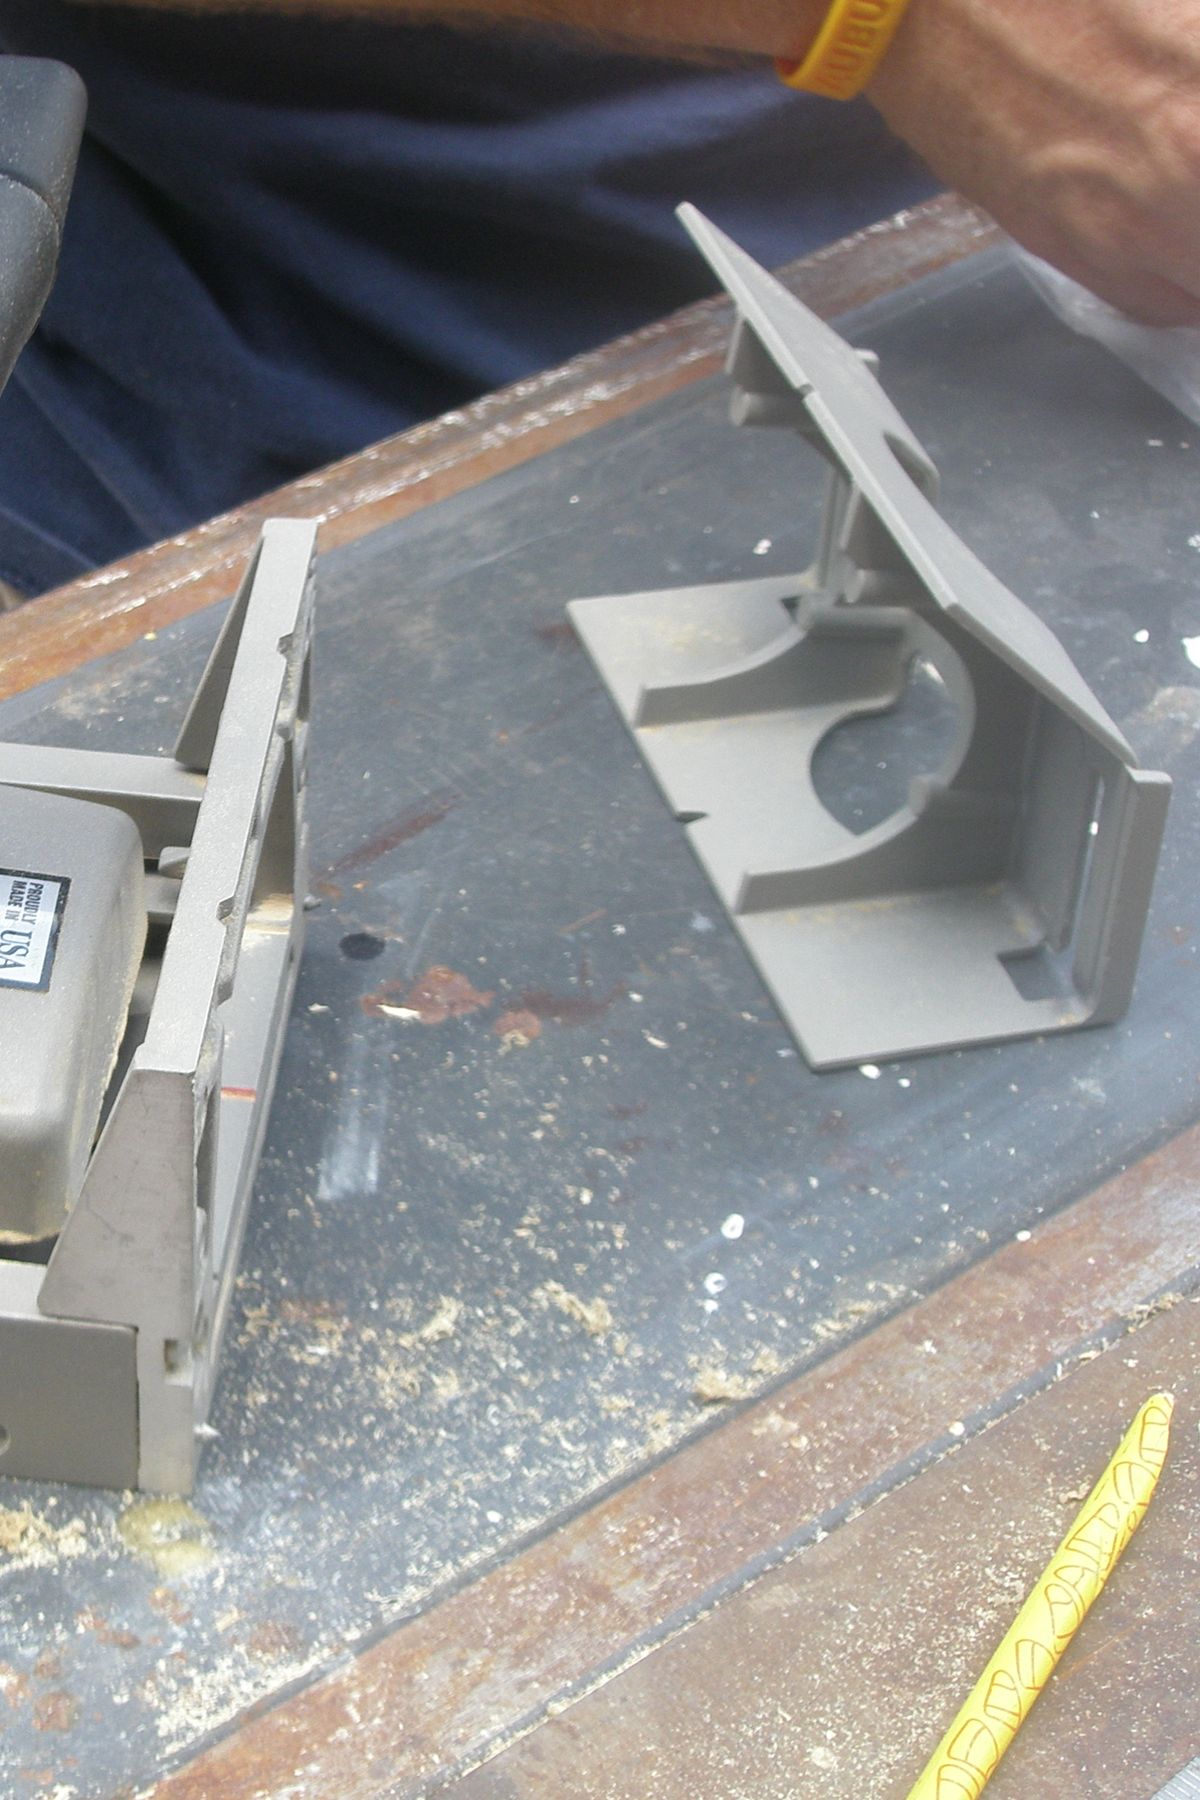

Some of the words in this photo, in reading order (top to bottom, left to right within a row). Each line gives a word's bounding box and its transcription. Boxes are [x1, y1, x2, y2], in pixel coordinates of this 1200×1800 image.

[7, 880, 28, 908] MADE
[21, 882, 44, 925] PROUDLY
[4, 909, 20, 921] IN
